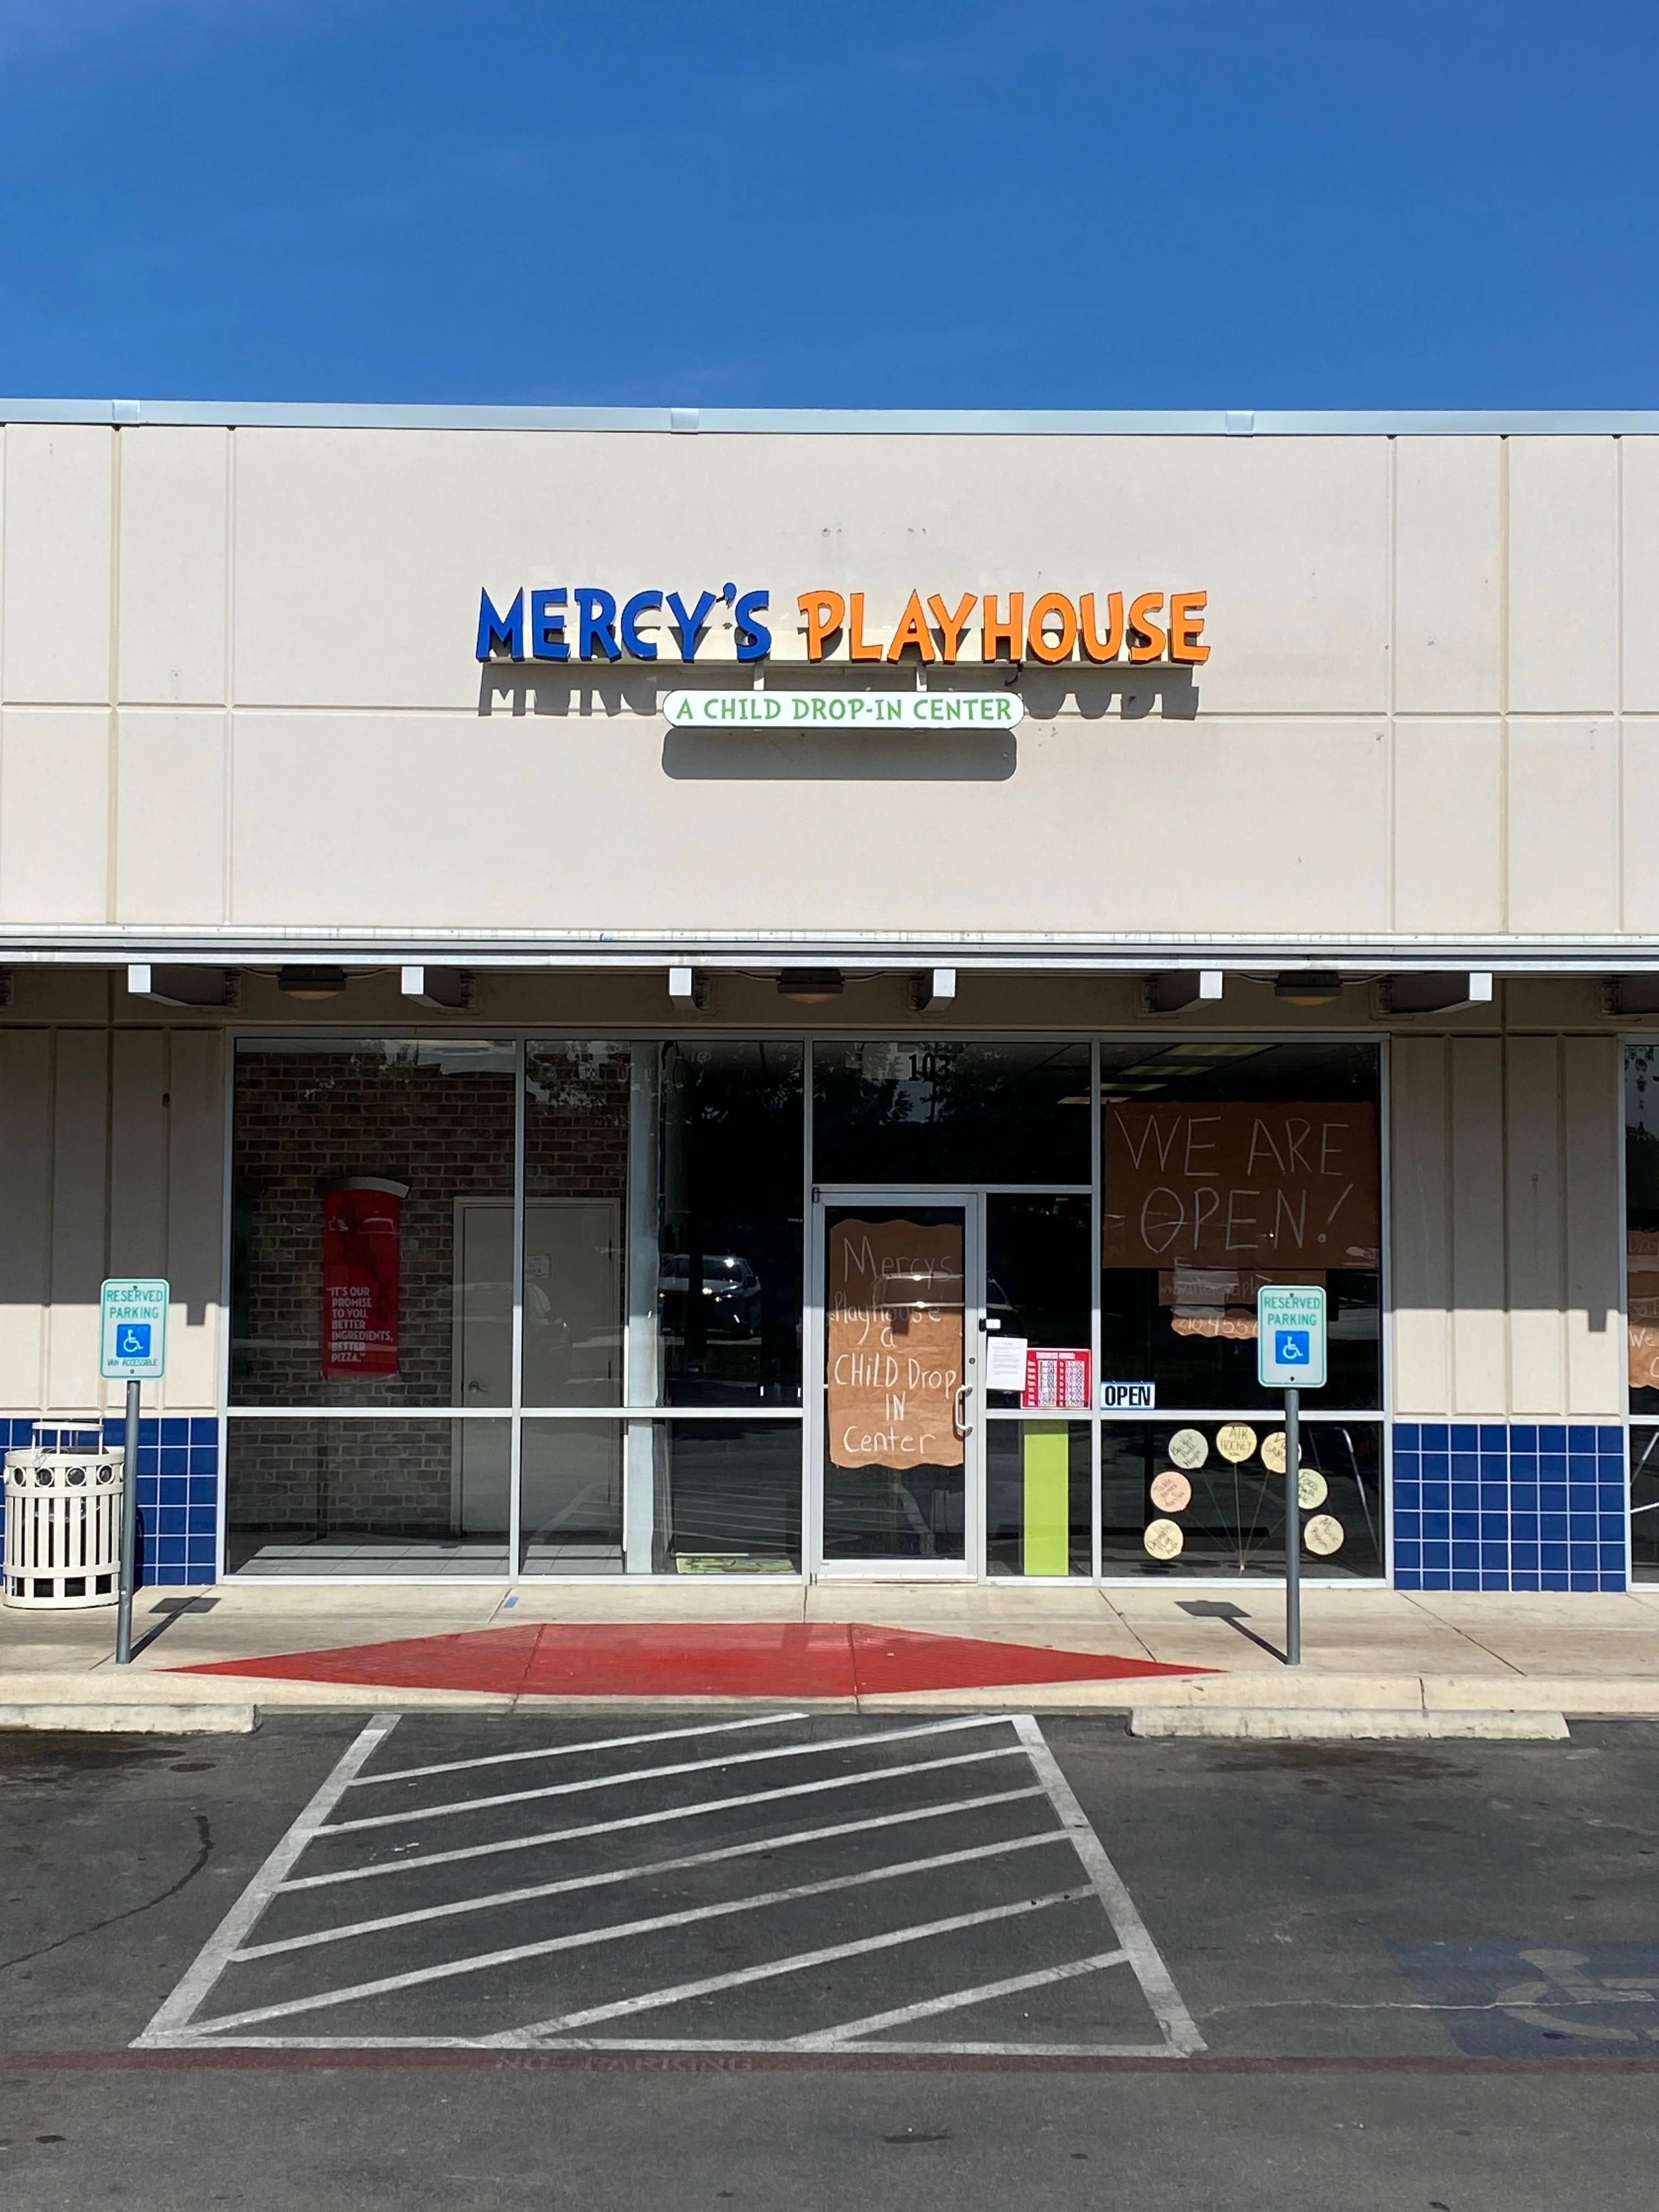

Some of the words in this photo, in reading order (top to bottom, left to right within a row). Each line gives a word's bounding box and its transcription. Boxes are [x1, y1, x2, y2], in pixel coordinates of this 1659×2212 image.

[476, 582, 772, 664] MERCY'S
[797, 589, 1211, 664] PLAYHOUSE
[676, 697, 694, 720] A
[704, 698, 781, 720] CHILD
[792, 698, 902, 720] DROP-IN
[913, 698, 1013, 720] CENTER
[909, 1053, 951, 1082] 103
[1114, 1109, 1222, 1177] WE
[1247, 1118, 1350, 1177] ARE
[1140, 1182, 1354, 1254] OPEN!
[106, 1290, 163, 1302] RESERVED
[350, 1286, 370, 1296] OUR
[331, 1297, 373, 1308] PROMISE
[1263, 1296, 1322, 1309] RESERVED
[109, 1307, 159, 1319] PARKING
[331, 1308, 345, 1319] TO
[1267, 1313, 1317, 1326] PARKING
[331, 1319, 366, 1330] BETTER
[331, 1341, 366, 1352] BETTER
[908, 1357, 957, 1400] Drop
[1104, 1385, 1151, 1406] OPEN
[885, 1390, 906, 1421] IN
[843, 1425, 936, 1454] Center
[1229, 1427, 1249, 1440] AIR
